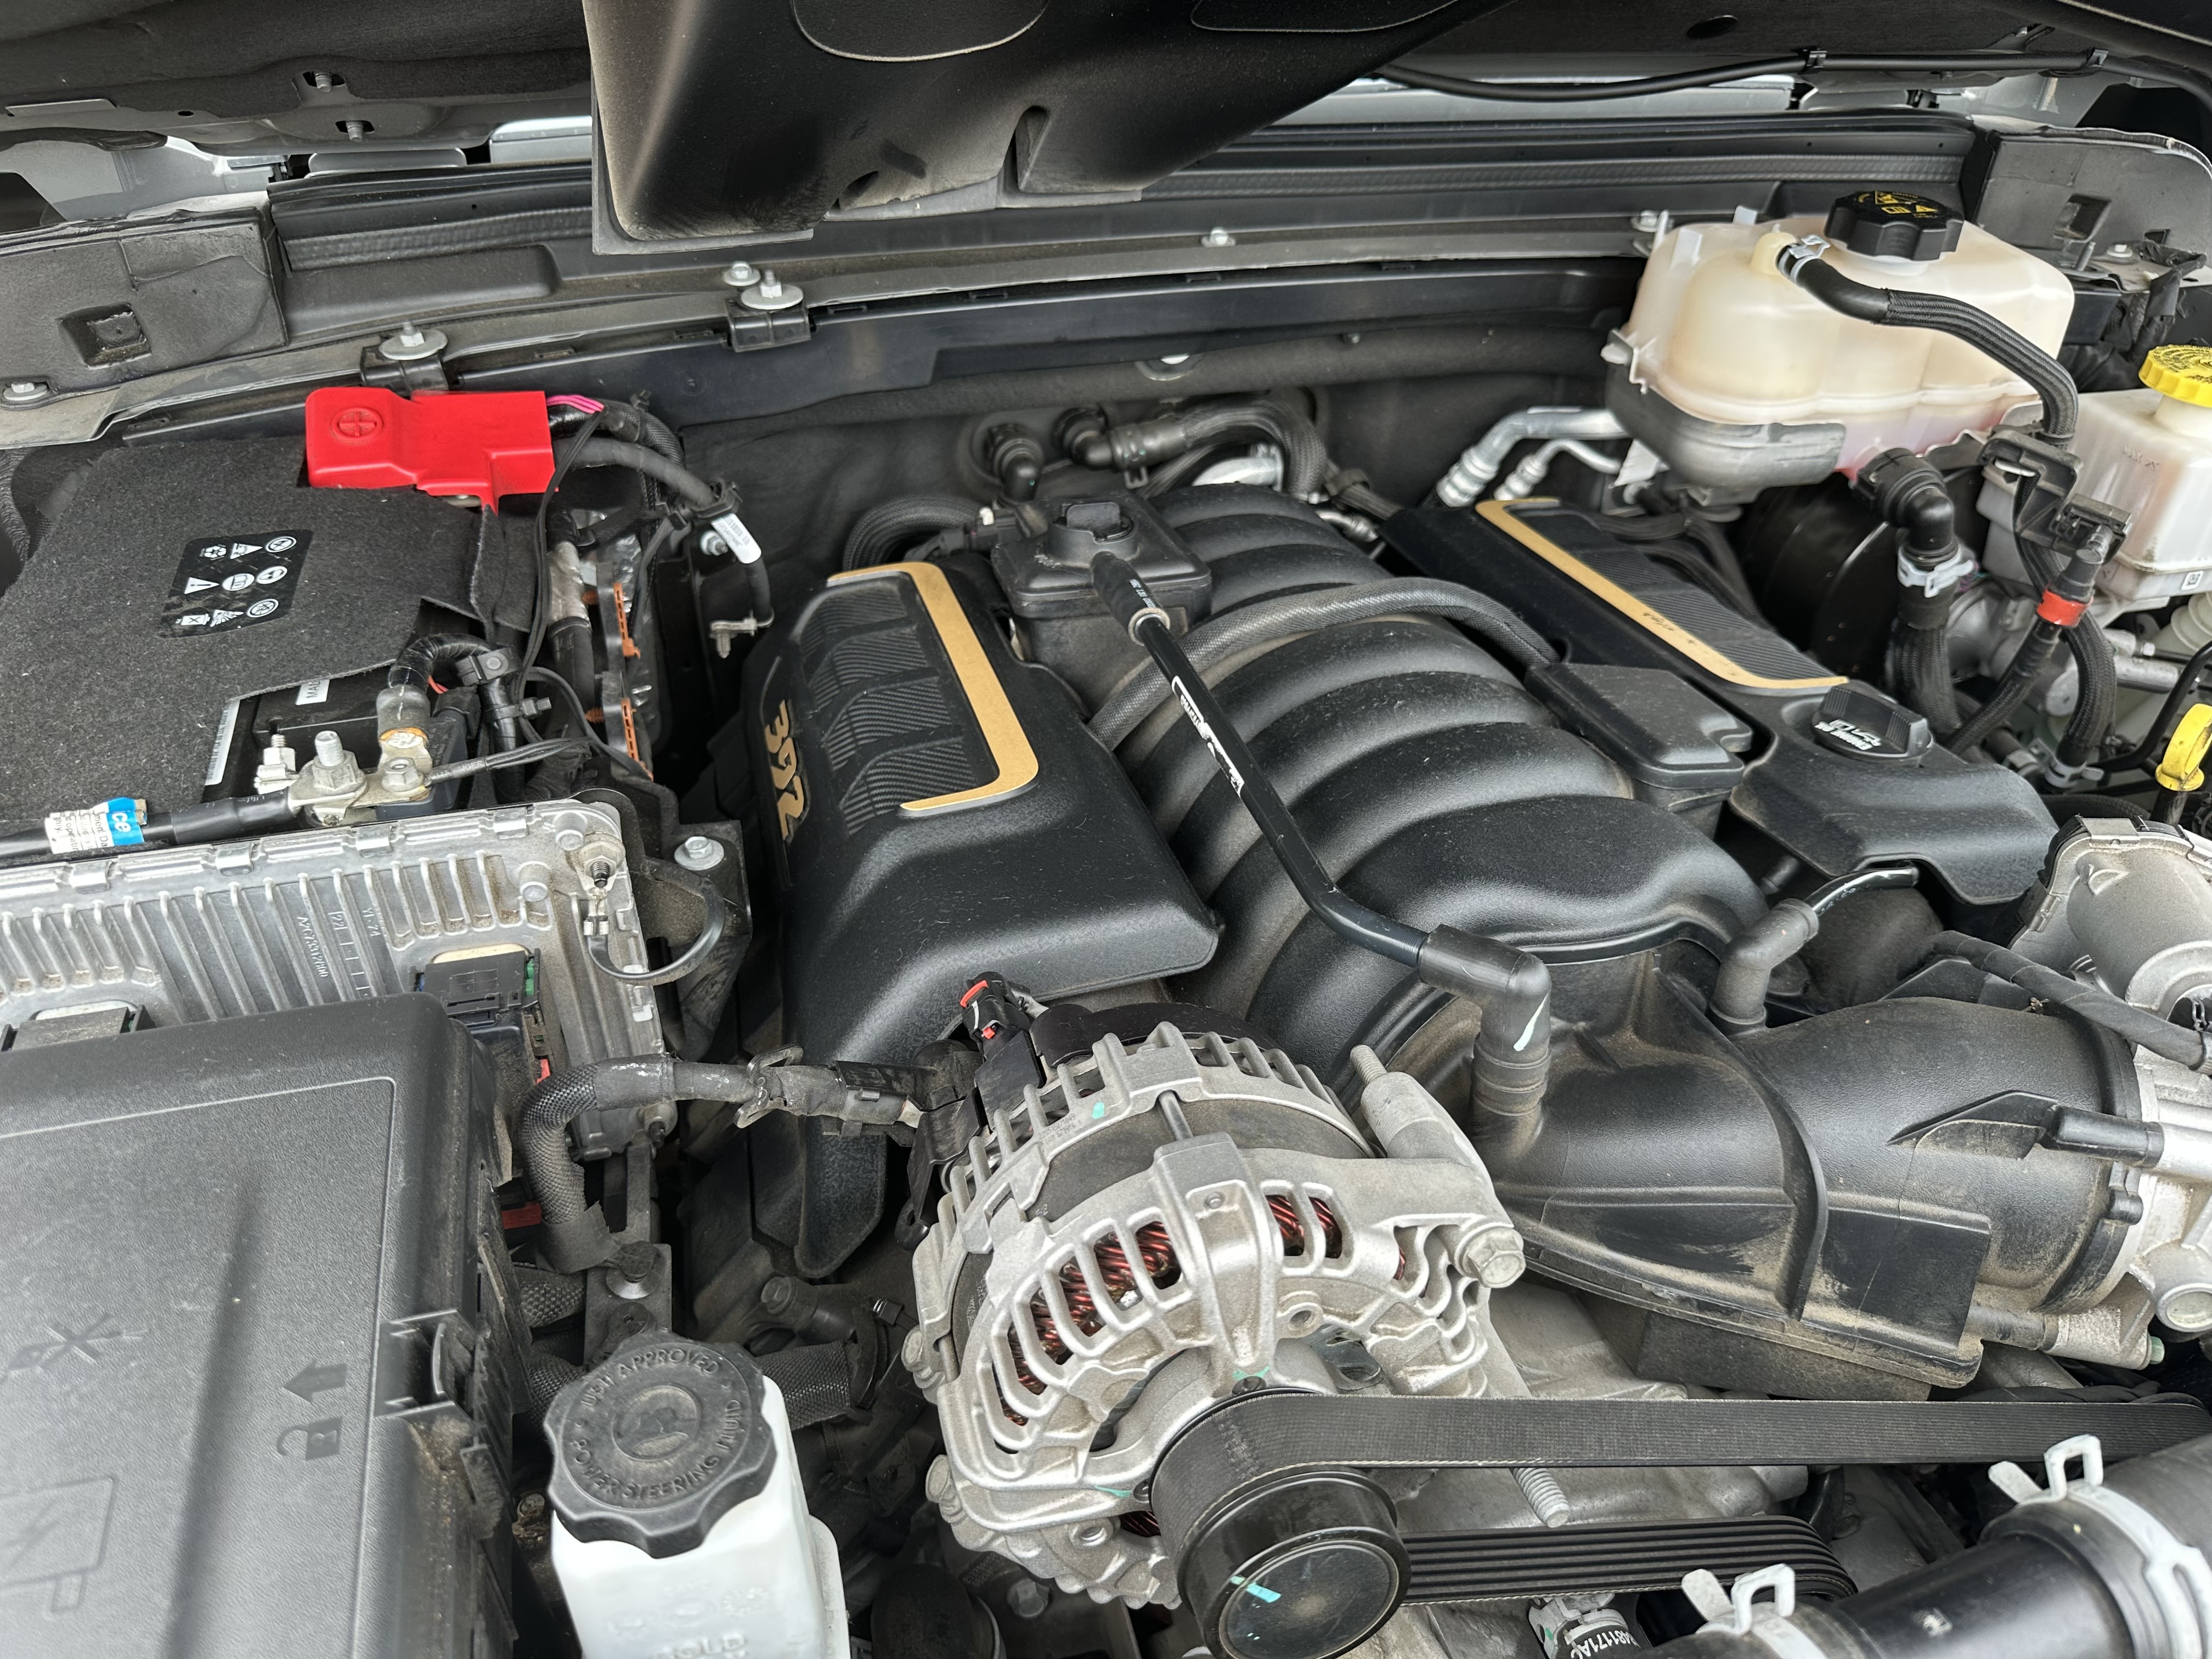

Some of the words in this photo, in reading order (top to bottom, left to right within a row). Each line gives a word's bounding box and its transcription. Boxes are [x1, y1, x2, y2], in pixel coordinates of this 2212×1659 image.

[1830, 729, 1872, 751] ENGINE
[765, 699, 805, 840] 392
[619, 1348, 720, 1380] APPROVED
[569, 1438, 620, 1496] POWER
[621, 1454, 720, 1500] STEERING
